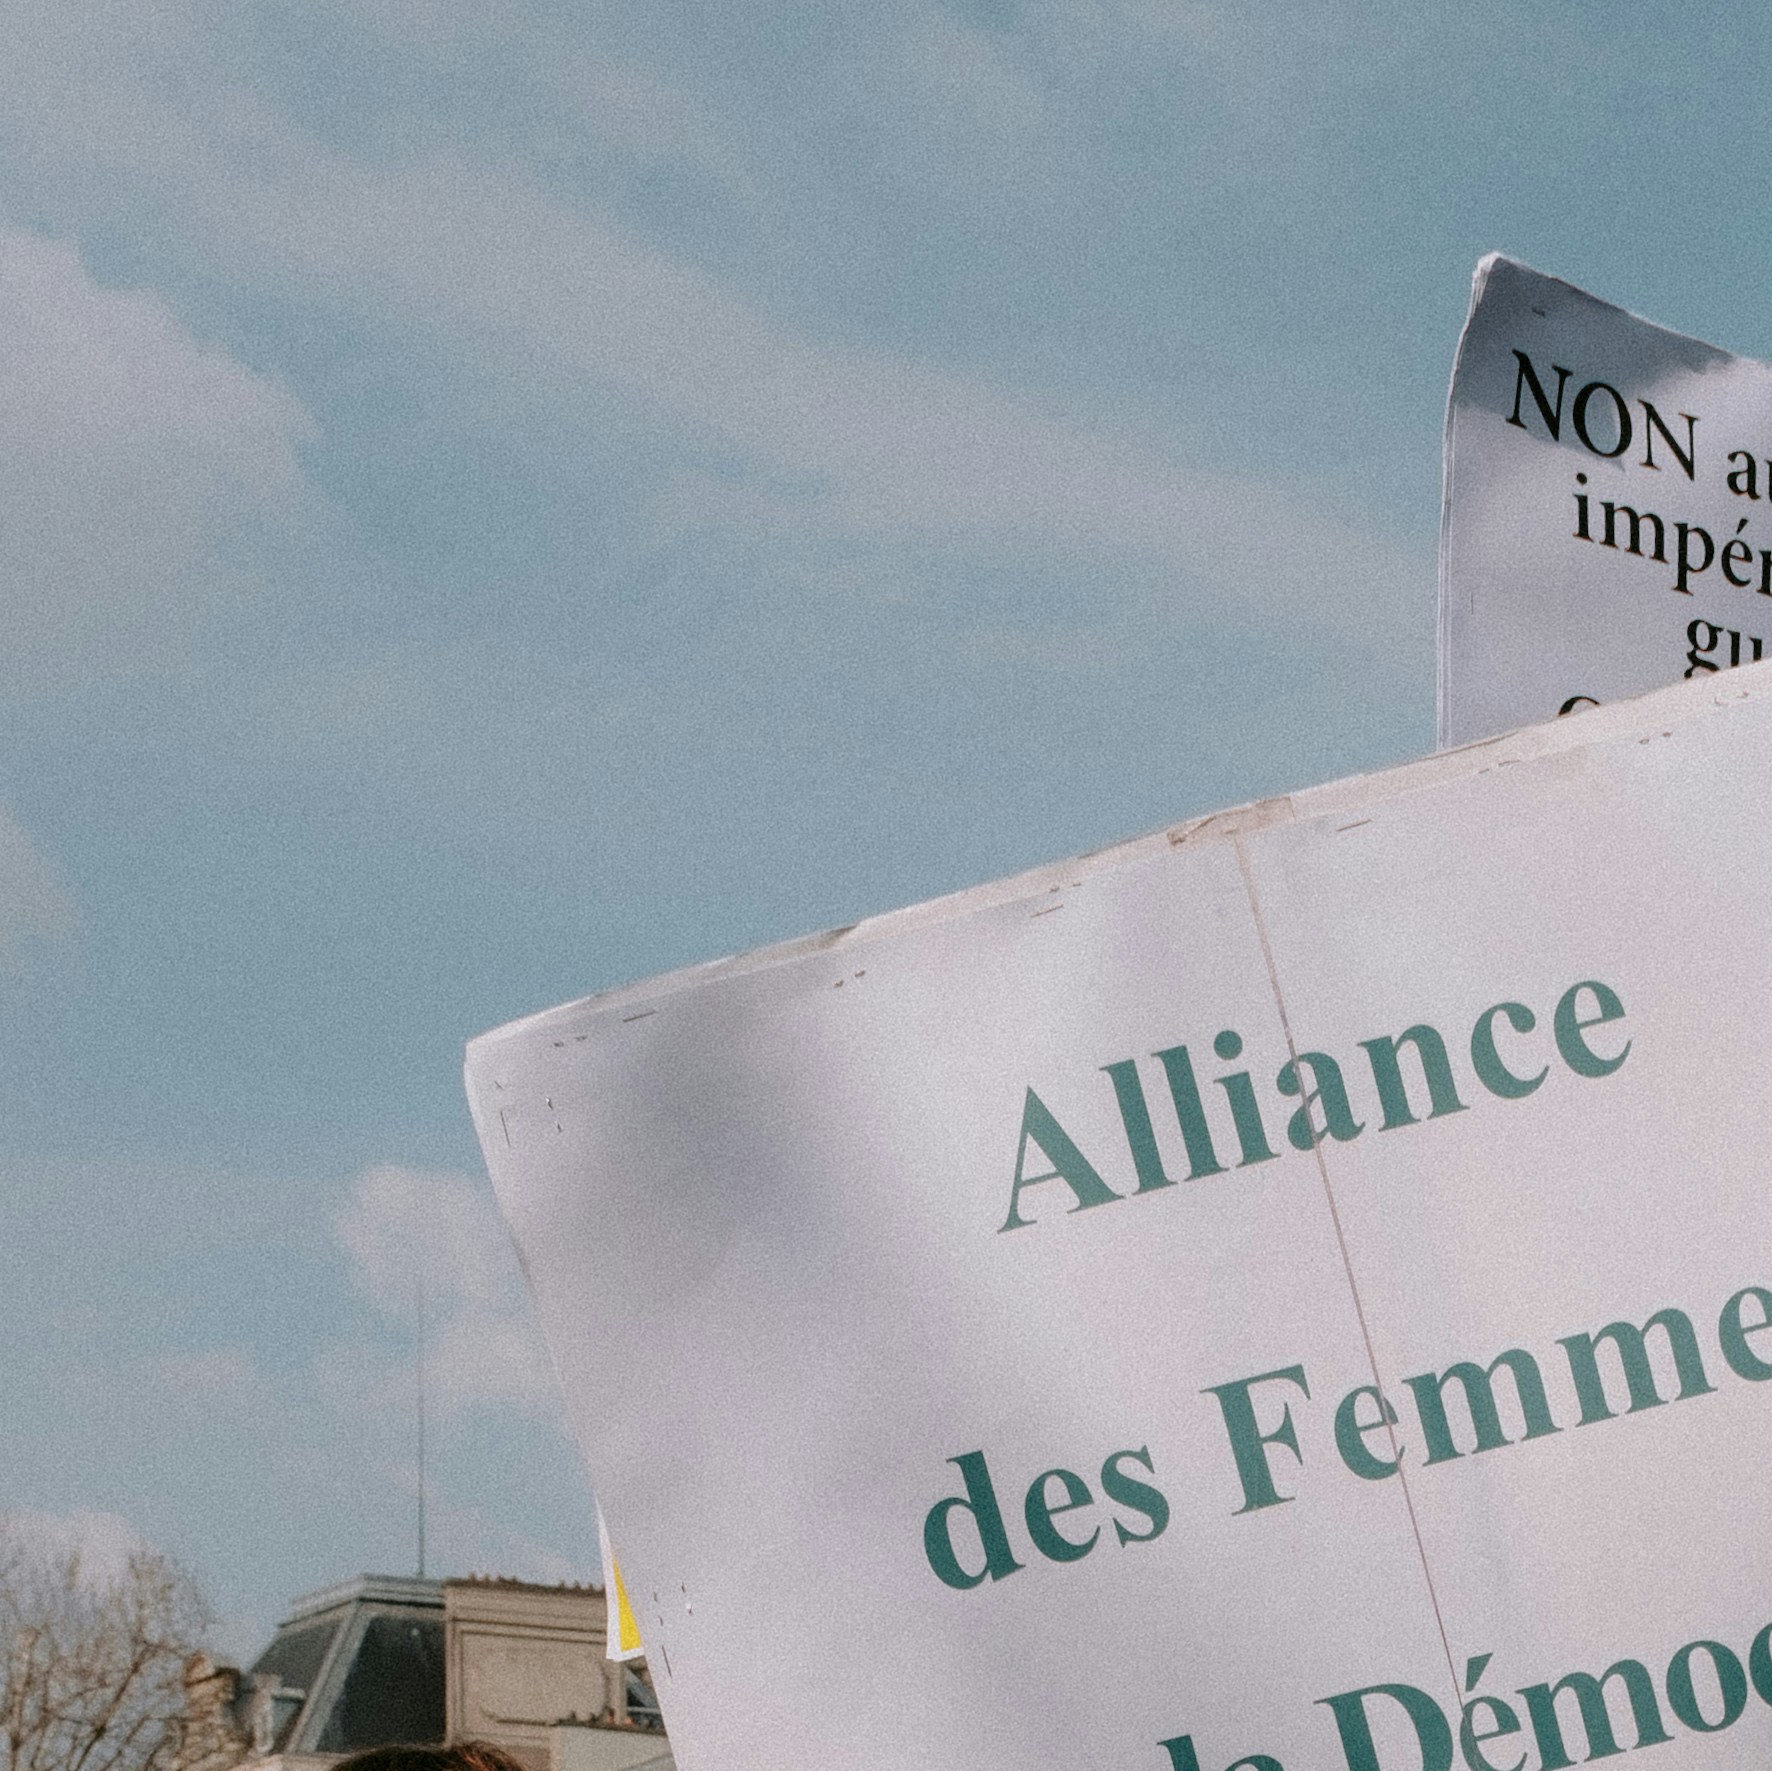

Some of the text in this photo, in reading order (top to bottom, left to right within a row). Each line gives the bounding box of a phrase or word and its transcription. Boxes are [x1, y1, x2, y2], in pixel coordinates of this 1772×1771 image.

[1505, 348, 1698, 481] NON
[998, 978, 1634, 1235] Alliance
[923, 1443, 1171, 1590] des
